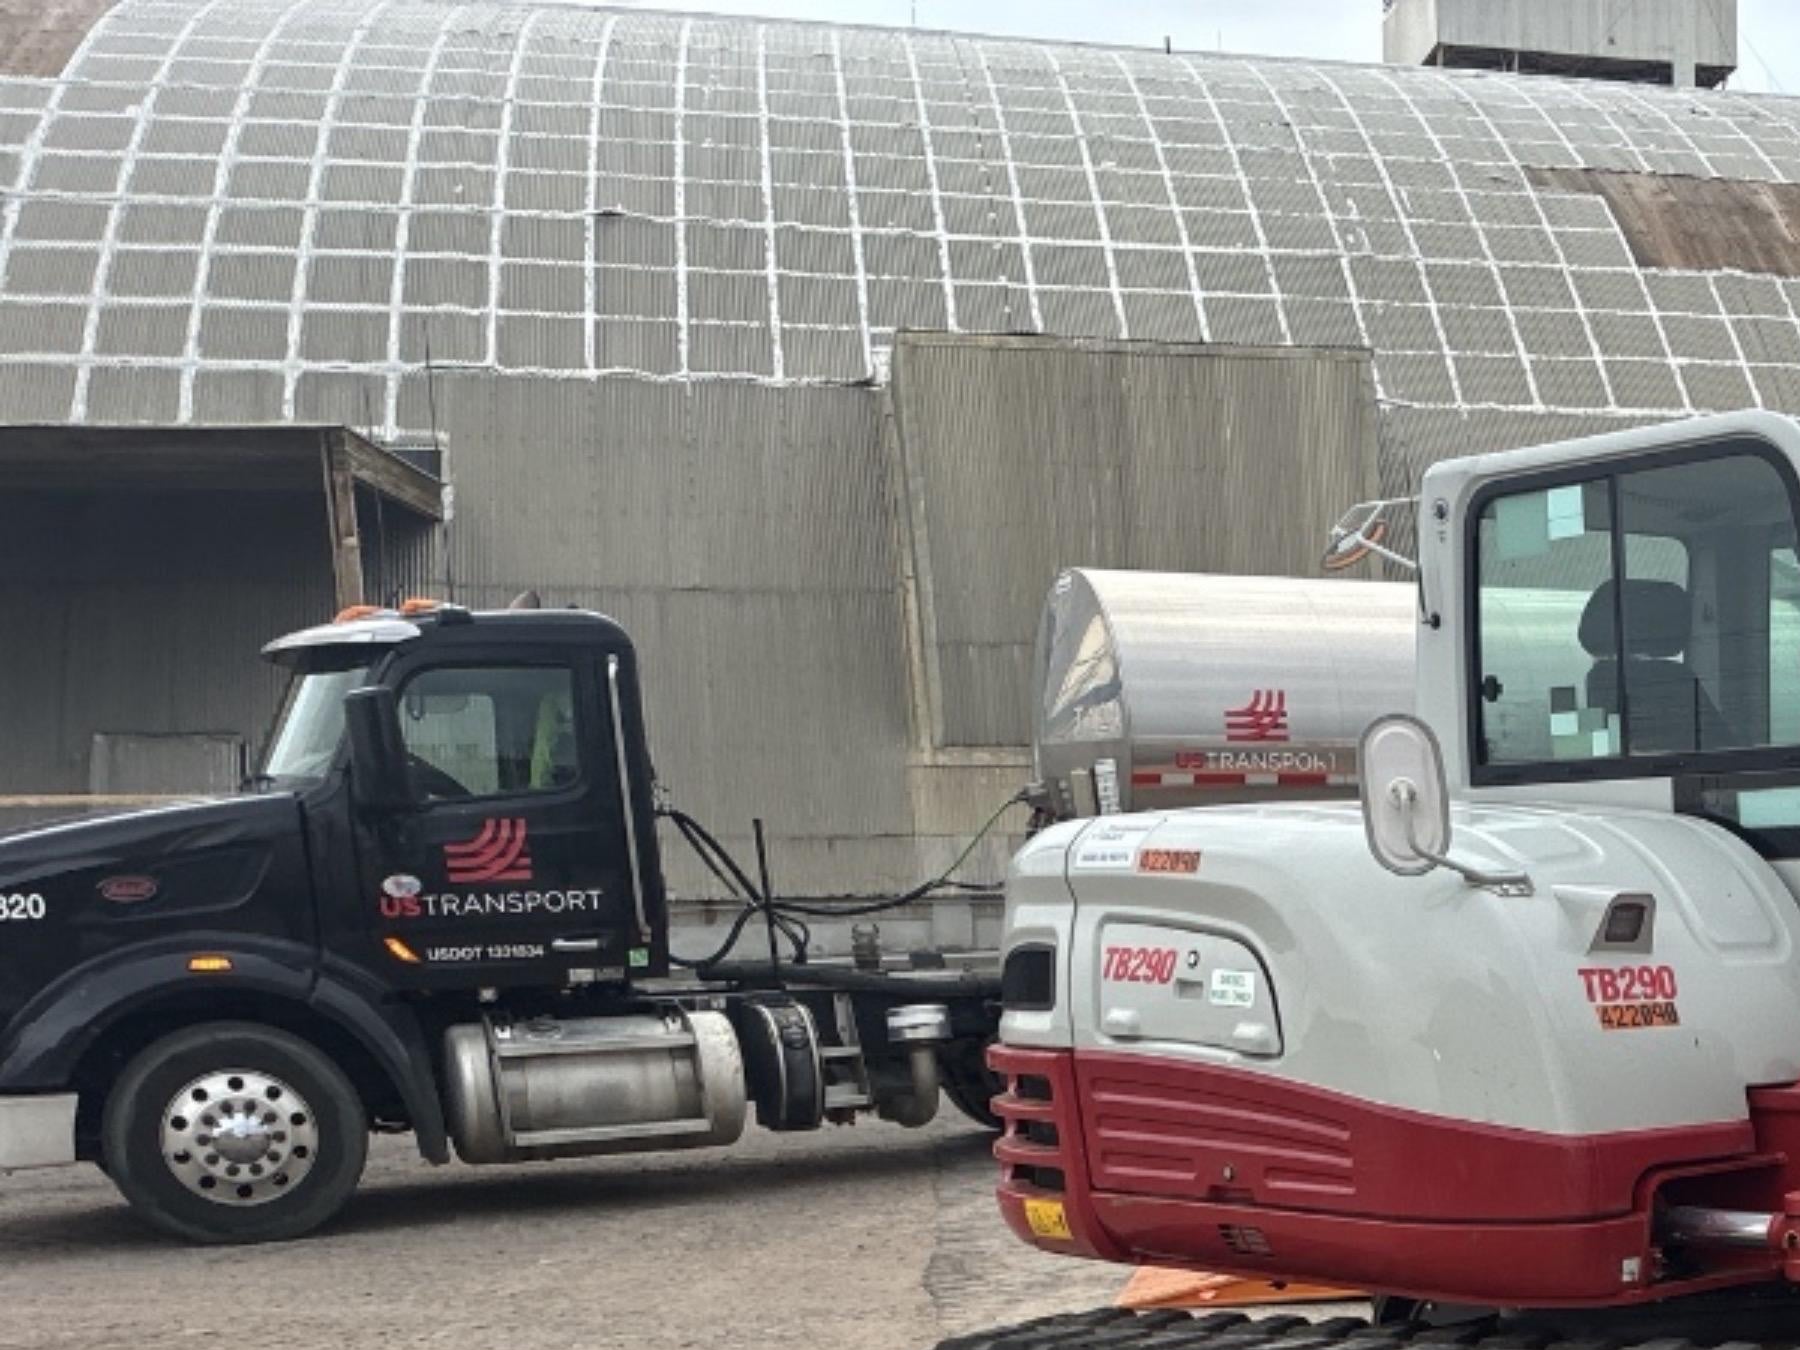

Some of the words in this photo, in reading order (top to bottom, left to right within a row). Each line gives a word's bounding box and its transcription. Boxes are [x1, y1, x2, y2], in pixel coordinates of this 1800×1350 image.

[428, 946, 482, 962] USDOT
[1103, 947, 1178, 984] TB290
[1577, 965, 1678, 1002] TB290
[1599, 1002, 1679, 1028] 422090
